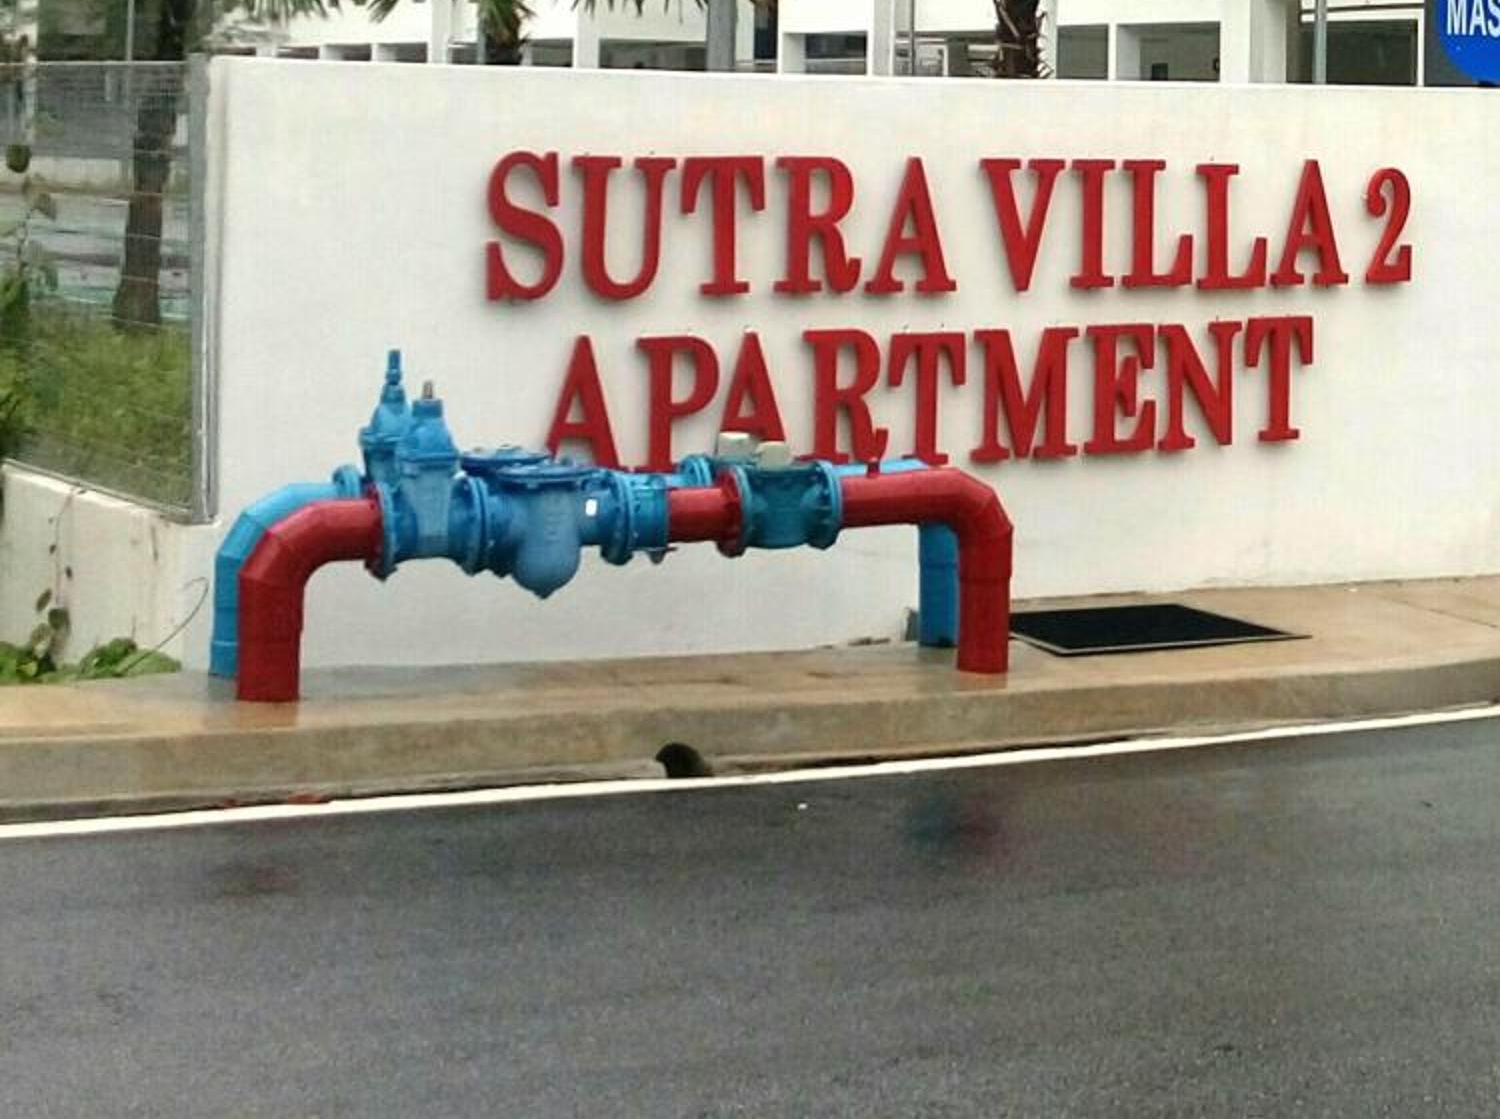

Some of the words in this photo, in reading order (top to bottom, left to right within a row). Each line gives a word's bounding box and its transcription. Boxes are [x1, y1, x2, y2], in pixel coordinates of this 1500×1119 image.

[486, 151, 957, 301] SUTRA
[981, 156, 1349, 292] VILLA
[1364, 166, 1413, 284] 2
[545, 315, 1314, 473] APARTMENT
